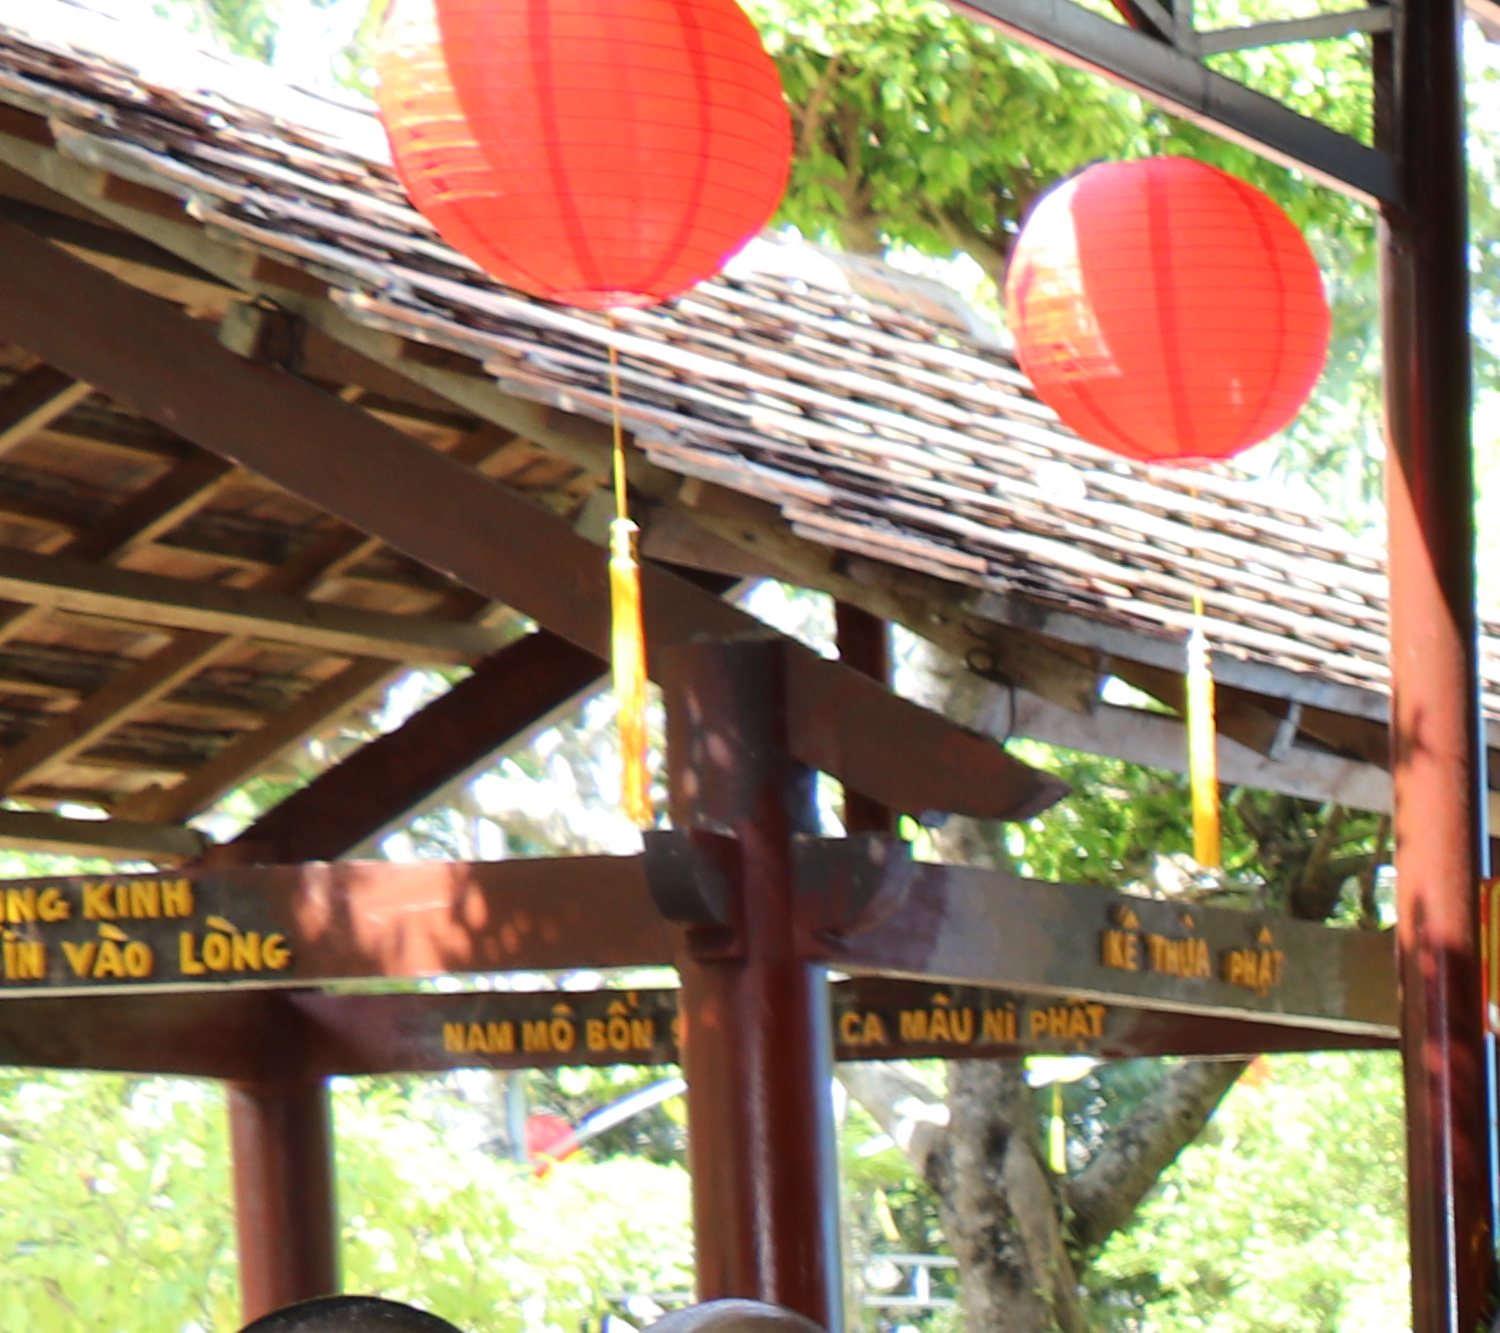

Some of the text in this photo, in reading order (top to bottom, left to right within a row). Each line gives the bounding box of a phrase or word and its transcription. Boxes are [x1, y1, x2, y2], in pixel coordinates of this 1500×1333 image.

[0, 878, 194, 923] NG KINH
[60, 922, 154, 978] VÀO
[178, 915, 292, 975] LÒNG
[1229, 926, 1285, 998] PHẬT
[443, 1021, 516, 1053] NAM
[522, 1002, 576, 1052] MÔ
[840, 1010, 888, 1044] CA
[900, 992, 974, 1044] MÂU
[1030, 996, 1106, 1051] PHẬT
